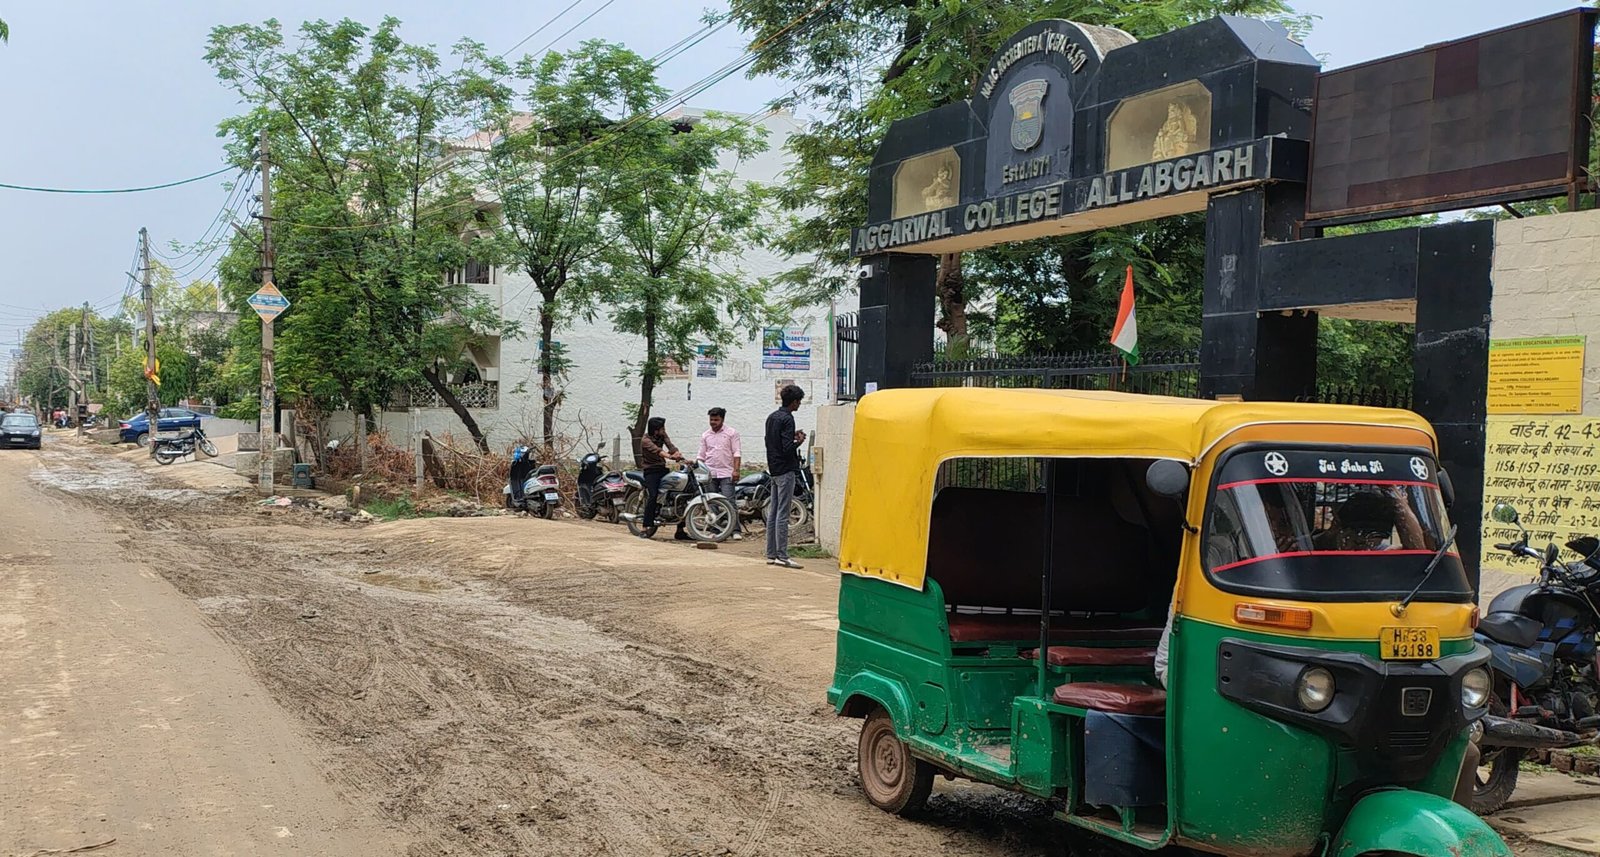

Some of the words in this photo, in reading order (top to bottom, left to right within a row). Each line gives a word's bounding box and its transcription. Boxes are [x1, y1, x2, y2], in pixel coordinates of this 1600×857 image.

[980, 67, 999, 99] NAAC
[997, 35, 1039, 75] ACCREDITED
[855, 211, 951, 252] AGGARWAL
[963, 186, 1062, 231] COLLEGE
[1509, 421, 1536, 438] वार्ड
[1495, 443, 1521, 456] मतदान
[1521, 442, 1540, 459] केन्द्र
[1541, 441, 1552, 455] की
[1319, 459, 1337, 473] Jai
[1369, 460, 1384, 474] Ki
[1517, 476, 1537, 493] केन्द्र
[1537, 479, 1550, 491] का
[1550, 479, 1571, 491] नाम
[1538, 497, 1550, 508] का
[1521, 510, 1535, 524] की
[1536, 510, 1561, 525] तिथि
[1492, 527, 1520, 541] मतदान
[1534, 530, 1556, 541] समय
